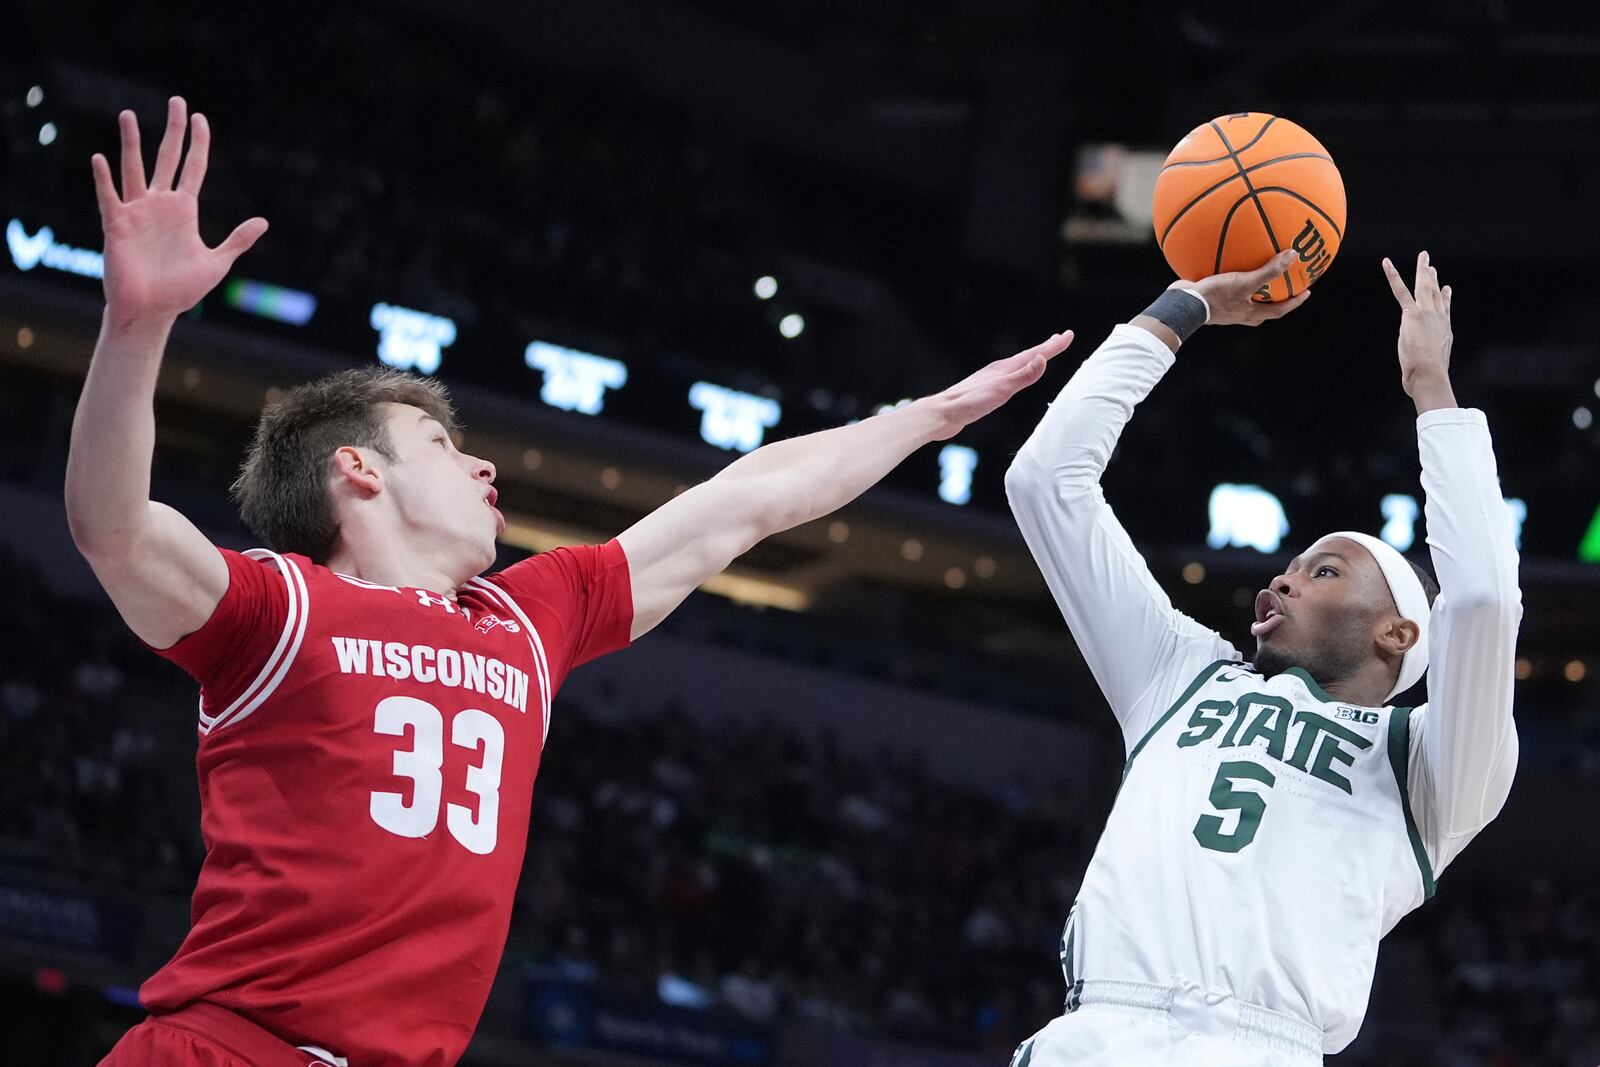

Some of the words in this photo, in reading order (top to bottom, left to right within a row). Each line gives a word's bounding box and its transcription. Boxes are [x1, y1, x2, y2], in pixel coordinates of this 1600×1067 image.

[331, 636, 529, 714] WISCONSIN
[369, 695, 505, 855] 33
[1176, 692, 1374, 796] STATE
[1192, 760, 1276, 853] 5
